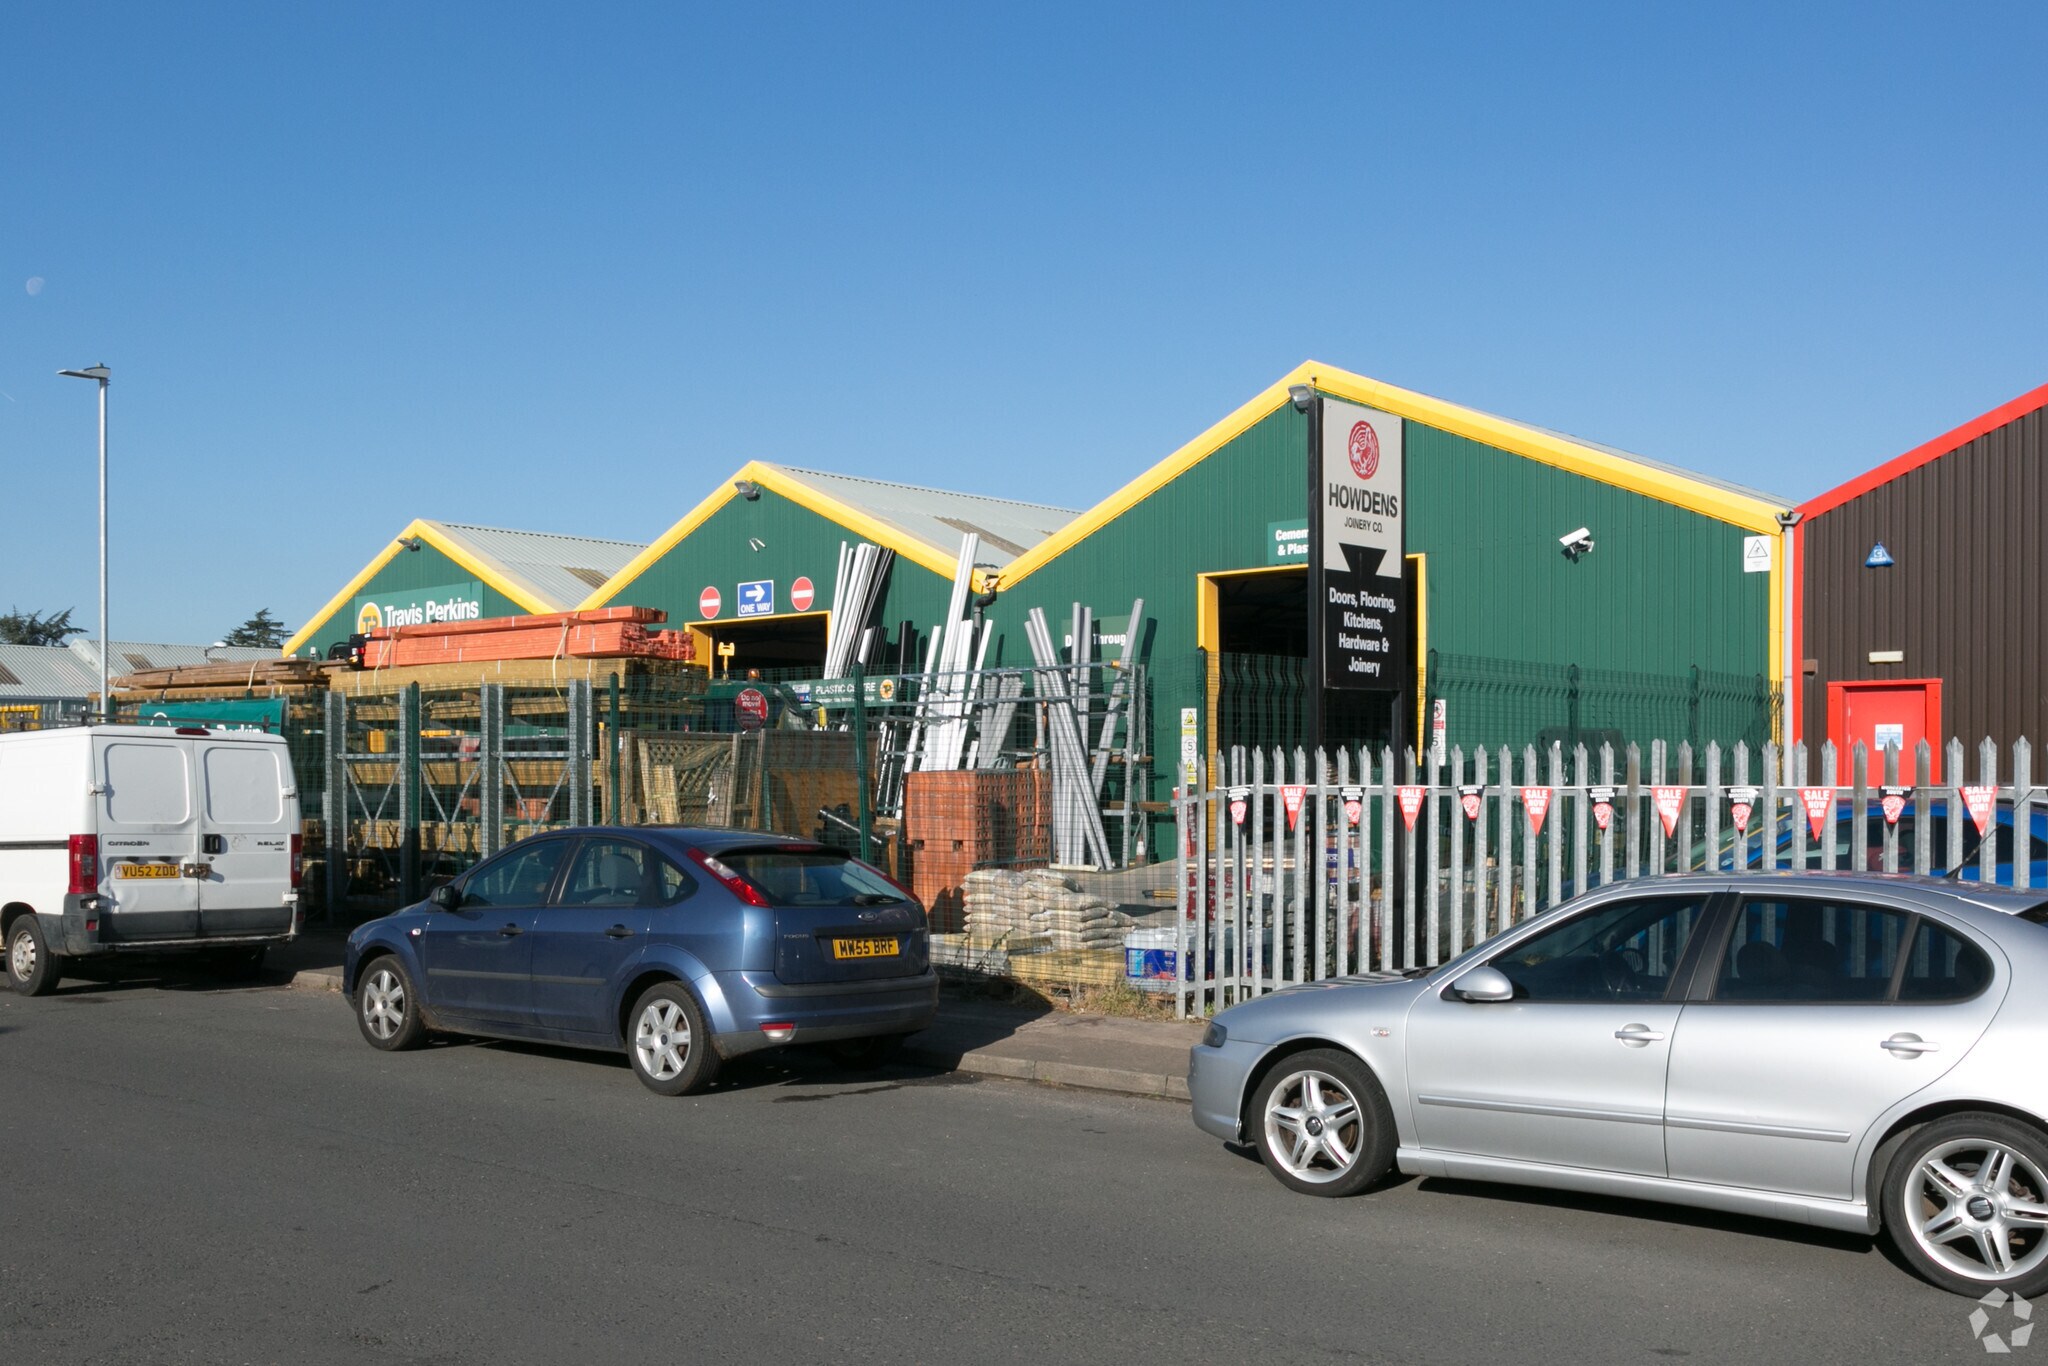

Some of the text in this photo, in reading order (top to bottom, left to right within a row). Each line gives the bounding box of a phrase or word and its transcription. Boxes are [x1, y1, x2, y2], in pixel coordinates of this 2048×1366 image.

[1329, 483, 1398, 518] HOWDENS
[1344, 517, 1383, 533] JOINERY CO.
[1275, 528, 1309, 541] Cemen
[1277, 543, 1309, 556] & Plas
[1329, 587, 1396, 613] Doors, Flooring,
[384, 597, 480, 629] Travis Perkins
[740, 602, 771, 614] ONE WAY
[1343, 611, 1383, 633] Kitchens,
[1092, 631, 1129, 647] Throug
[1339, 632, 1390, 653] Hardware &
[1348, 656, 1381, 677] Joinery
[815, 684, 846, 695] PLASTIC
[846, 682, 877, 693] CRE
[1187, 741, 1194, 751] 5
[1283, 788, 1303, 796] SALE
[1401, 788, 1421, 798] SALE
[1525, 789, 1548, 799] SALE
[1656, 788, 1682, 800] SALE
[1803, 789, 1830, 801] SALE
[1964, 785, 1994, 795] SALE
[1807, 800, 1827, 809] NOW
[1968, 794, 1991, 804] NOW
[1529, 807, 1544, 815] ON!
[1809, 808, 1825, 818] ON!
[1971, 803, 1989, 813] ON!
[122, 865, 152, 877] VU52
[839, 939, 894, 957] MW55 BRF
